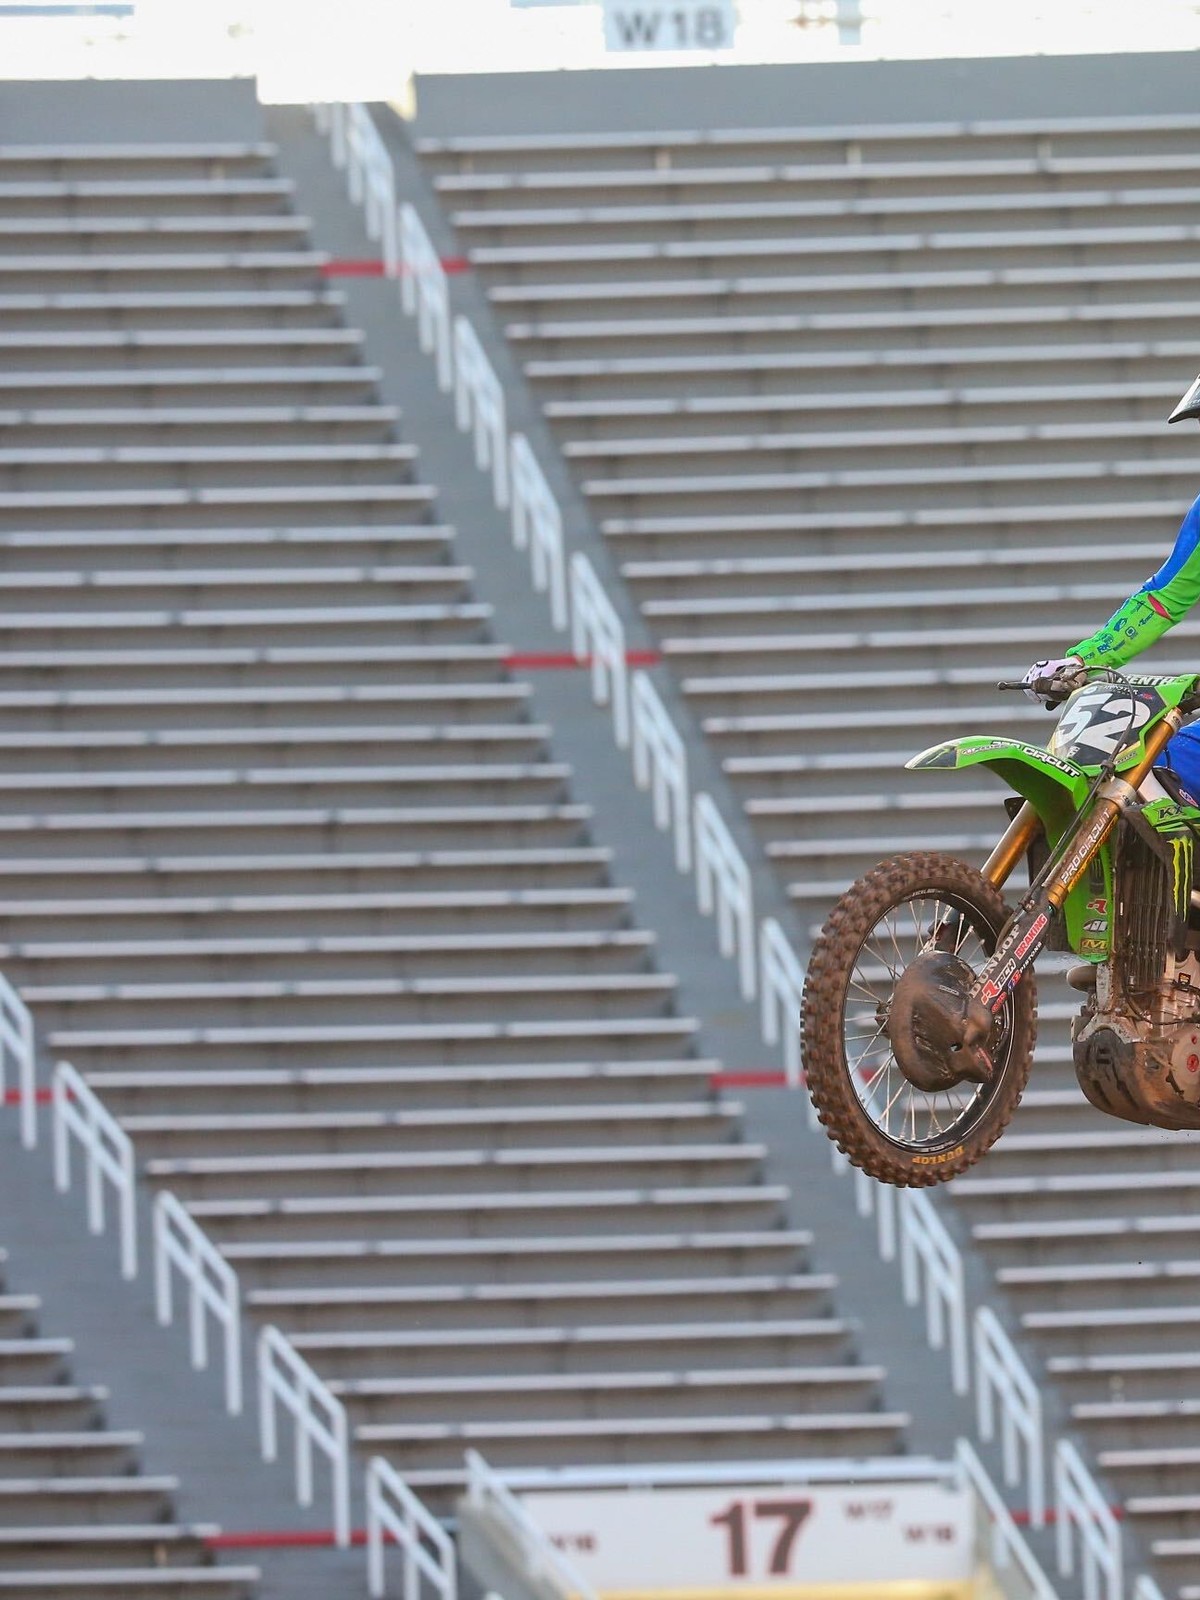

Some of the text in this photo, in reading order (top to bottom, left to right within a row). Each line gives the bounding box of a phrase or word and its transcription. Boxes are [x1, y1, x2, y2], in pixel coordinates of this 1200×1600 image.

[612, 9, 724, 48] W18
[1053, 692, 1151, 757] 52
[1022, 746, 1081, 778] CIRCUIT
[1060, 807, 1111, 884] PRO CIRCUIT
[969, 923, 1021, 999] DUNLOP
[1014, 913, 1048, 960] BRAKING
[708, 1500, 814, 1577] 17
